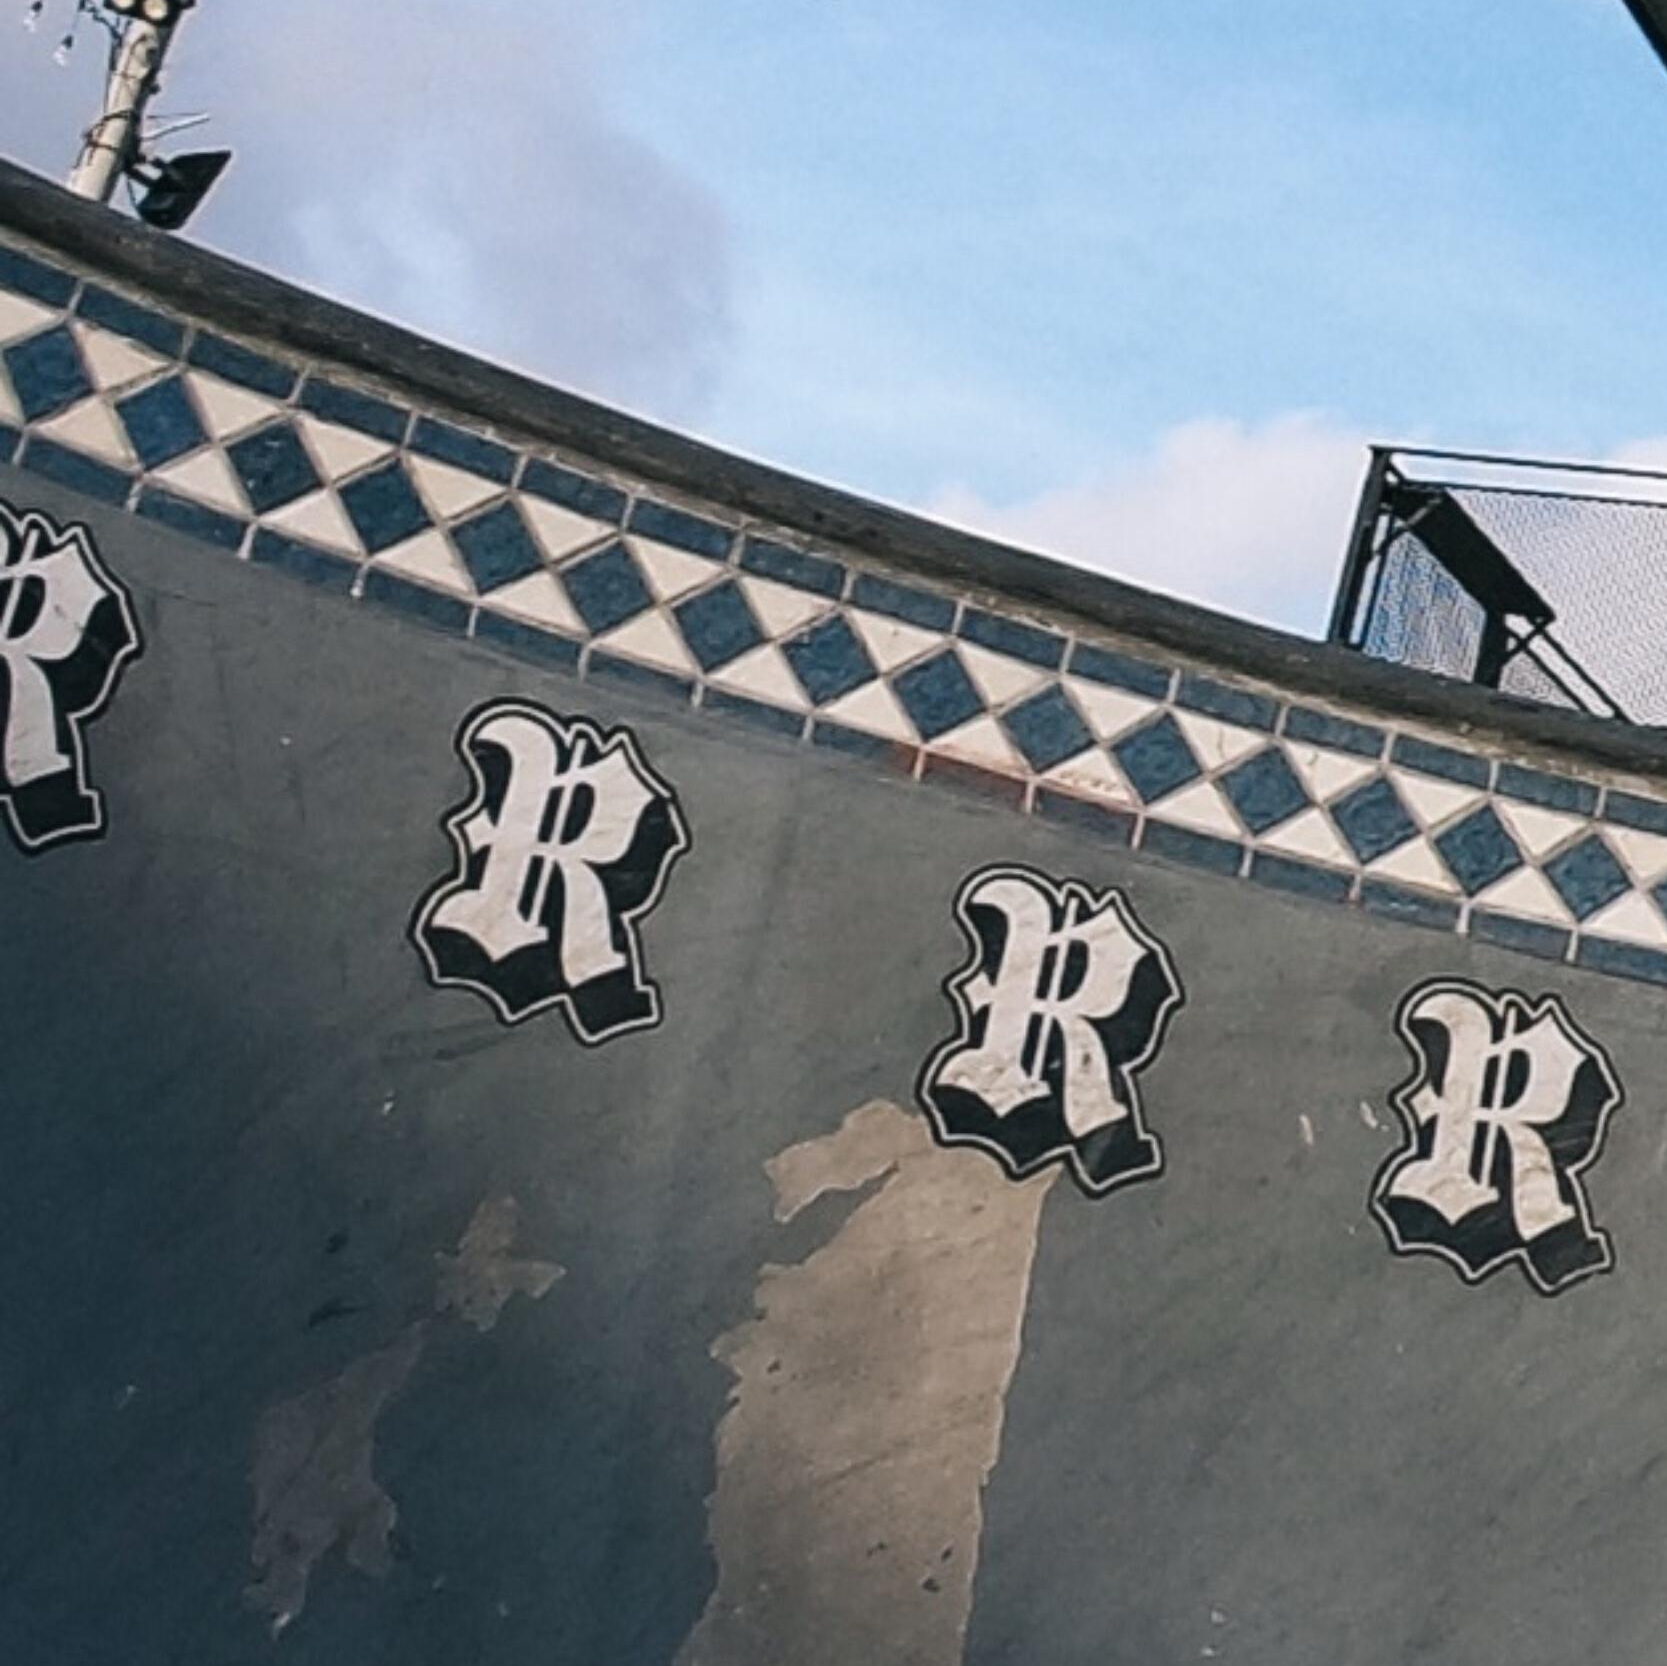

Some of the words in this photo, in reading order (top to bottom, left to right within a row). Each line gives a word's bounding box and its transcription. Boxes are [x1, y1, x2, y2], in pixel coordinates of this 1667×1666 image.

[416, 704, 685, 1037] R
[920, 868, 1178, 1191] R
[1374, 982, 1618, 1288] R
